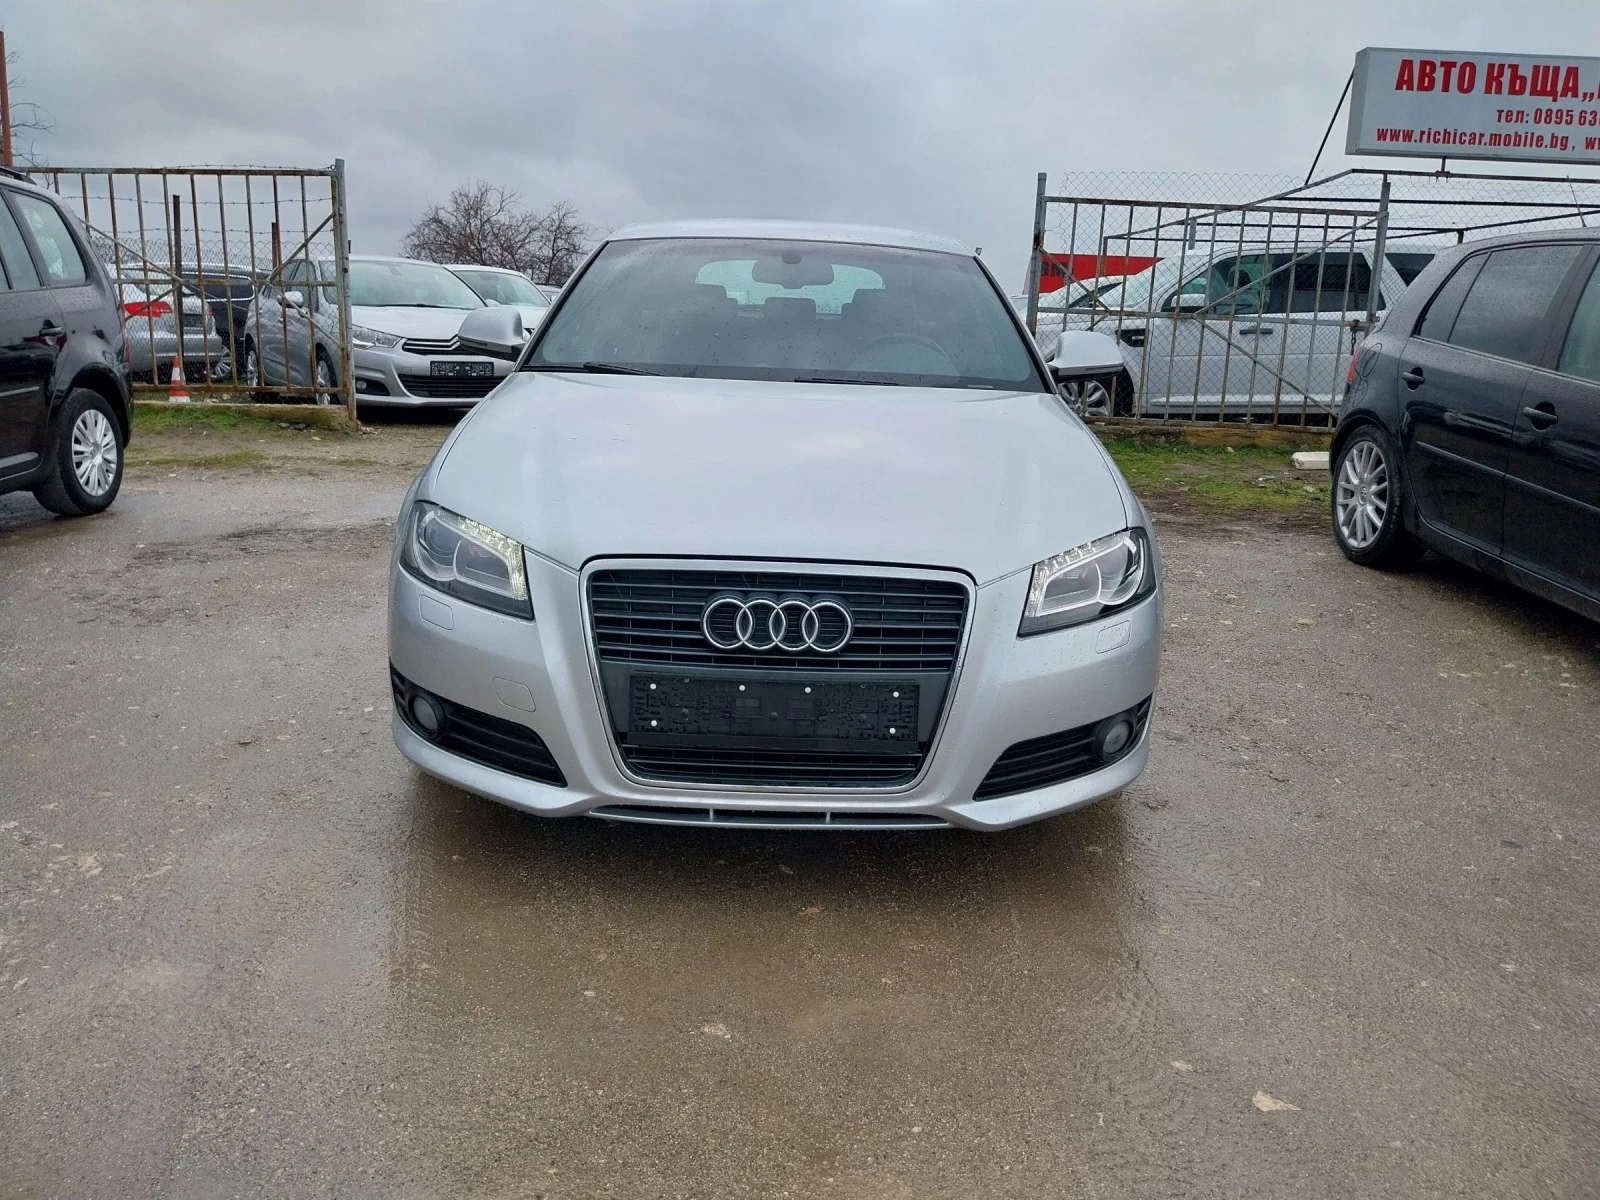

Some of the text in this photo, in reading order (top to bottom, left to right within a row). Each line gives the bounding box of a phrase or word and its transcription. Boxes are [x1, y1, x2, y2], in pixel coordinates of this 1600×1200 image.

[1394, 58, 1477, 94] АВТО
[1496, 107, 1600, 127] тел: 0895 63
